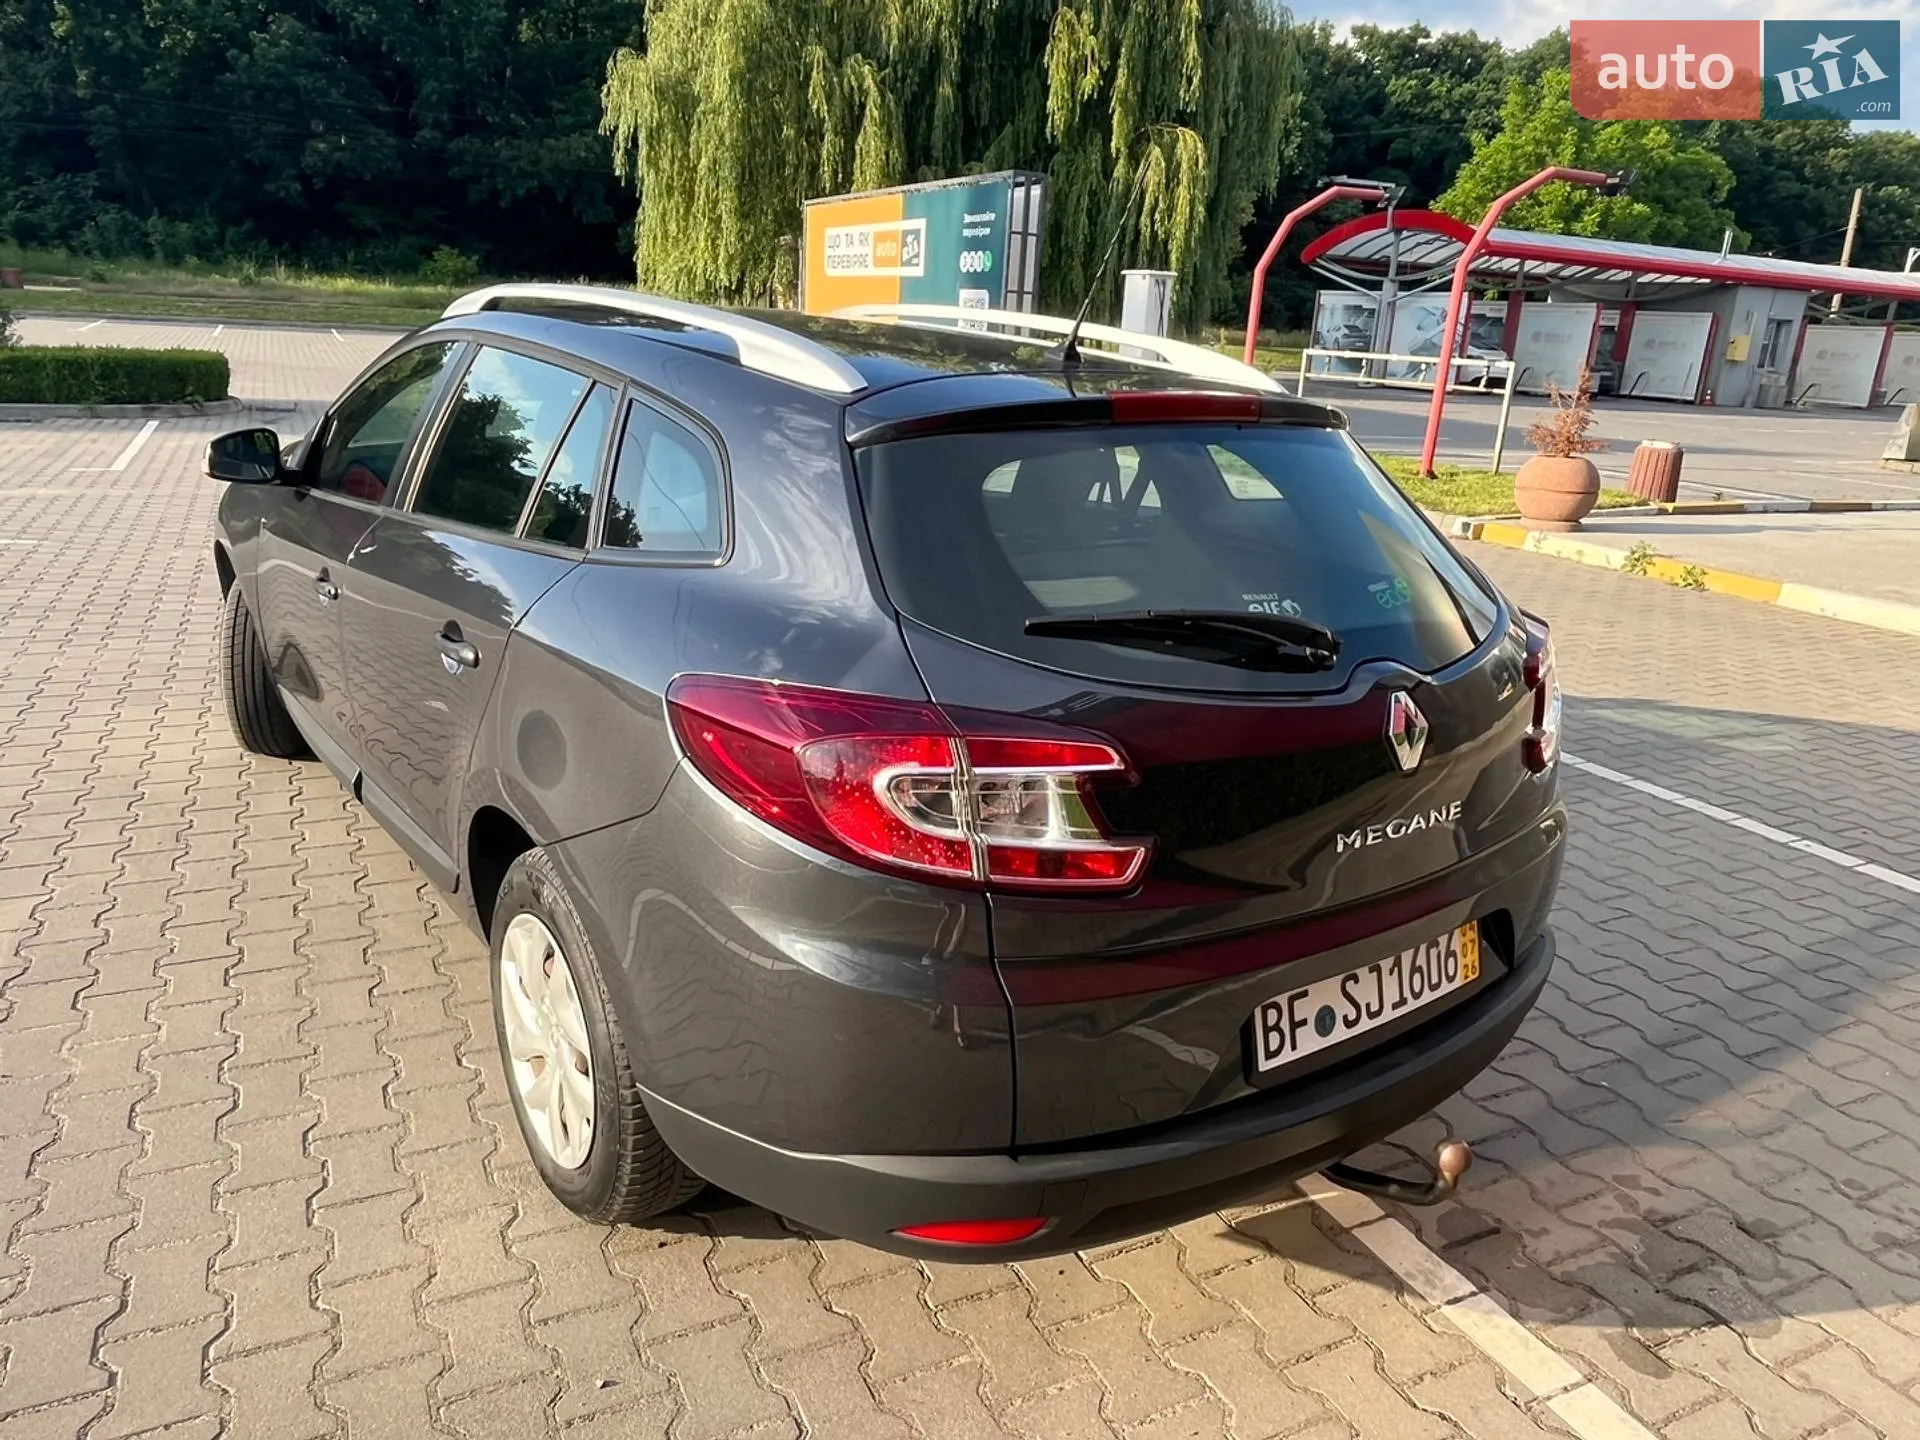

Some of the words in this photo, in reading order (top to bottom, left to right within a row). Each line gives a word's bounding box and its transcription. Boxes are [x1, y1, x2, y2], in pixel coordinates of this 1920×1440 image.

[827, 233, 841, 251] ЩО
[844, 232, 854, 248] ТА
[858, 231, 870, 247] ЯК
[876, 240, 897, 257] auto
[1335, 800, 1464, 853] MEGANE
[1463, 960, 1478, 980] 26
[1261, 990, 1310, 1062] BF
[1340, 930, 1459, 1030] SJ1606
